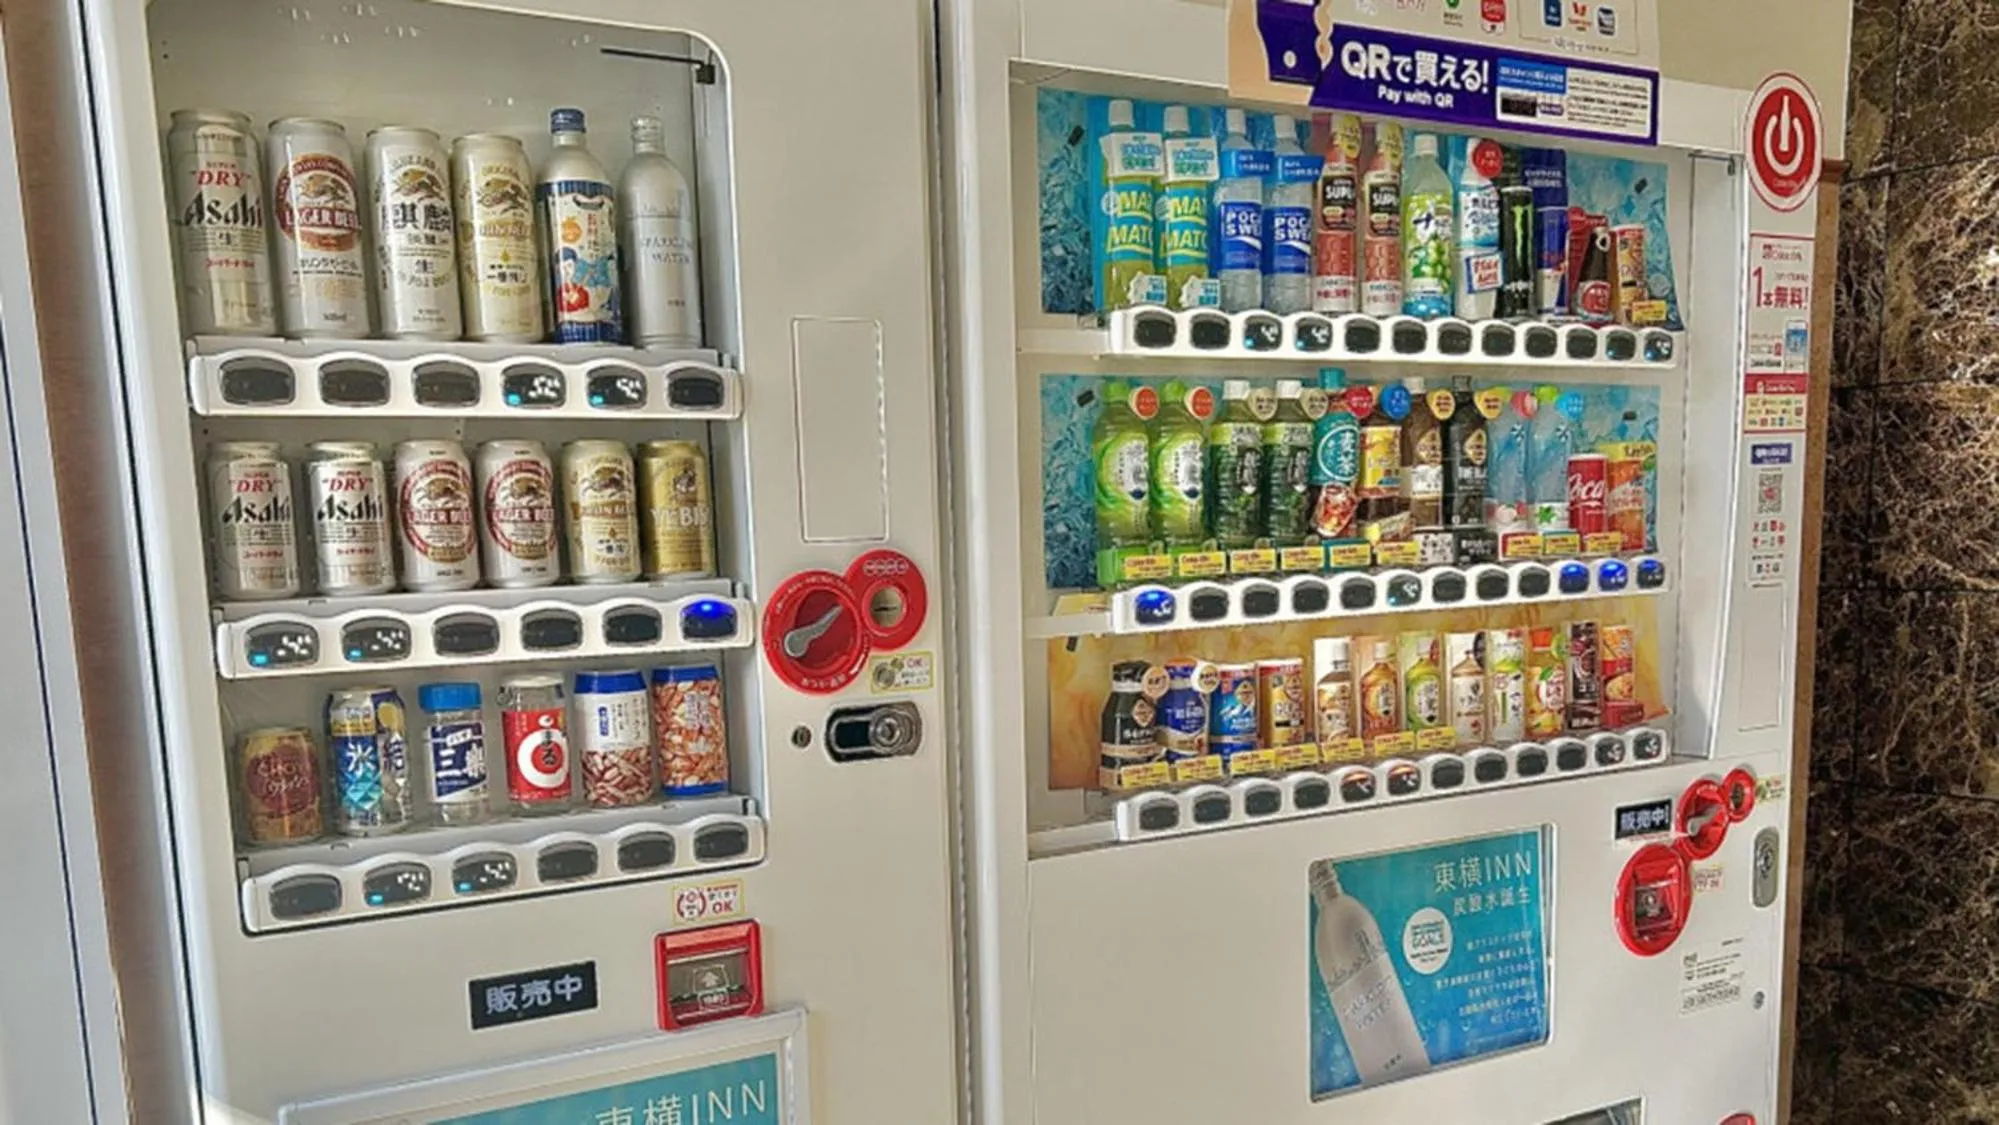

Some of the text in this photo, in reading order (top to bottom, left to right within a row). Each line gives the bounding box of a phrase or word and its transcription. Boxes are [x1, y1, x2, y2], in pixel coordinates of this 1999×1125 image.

[1341, 41, 1489, 94] QRで買える!
[1377, 84, 1454, 109] Pay with QR
[175, 191, 263, 228] Asahi
[1118, 191, 1152, 213] MA
[1171, 196, 1206, 218] MA
[222, 496, 291, 524] Asahi
[317, 495, 384, 521] Asahi
[1434, 849, 1532, 892] 東横INN
[712, 900, 733, 914] OK
[485, 973, 584, 1015] 販売中
